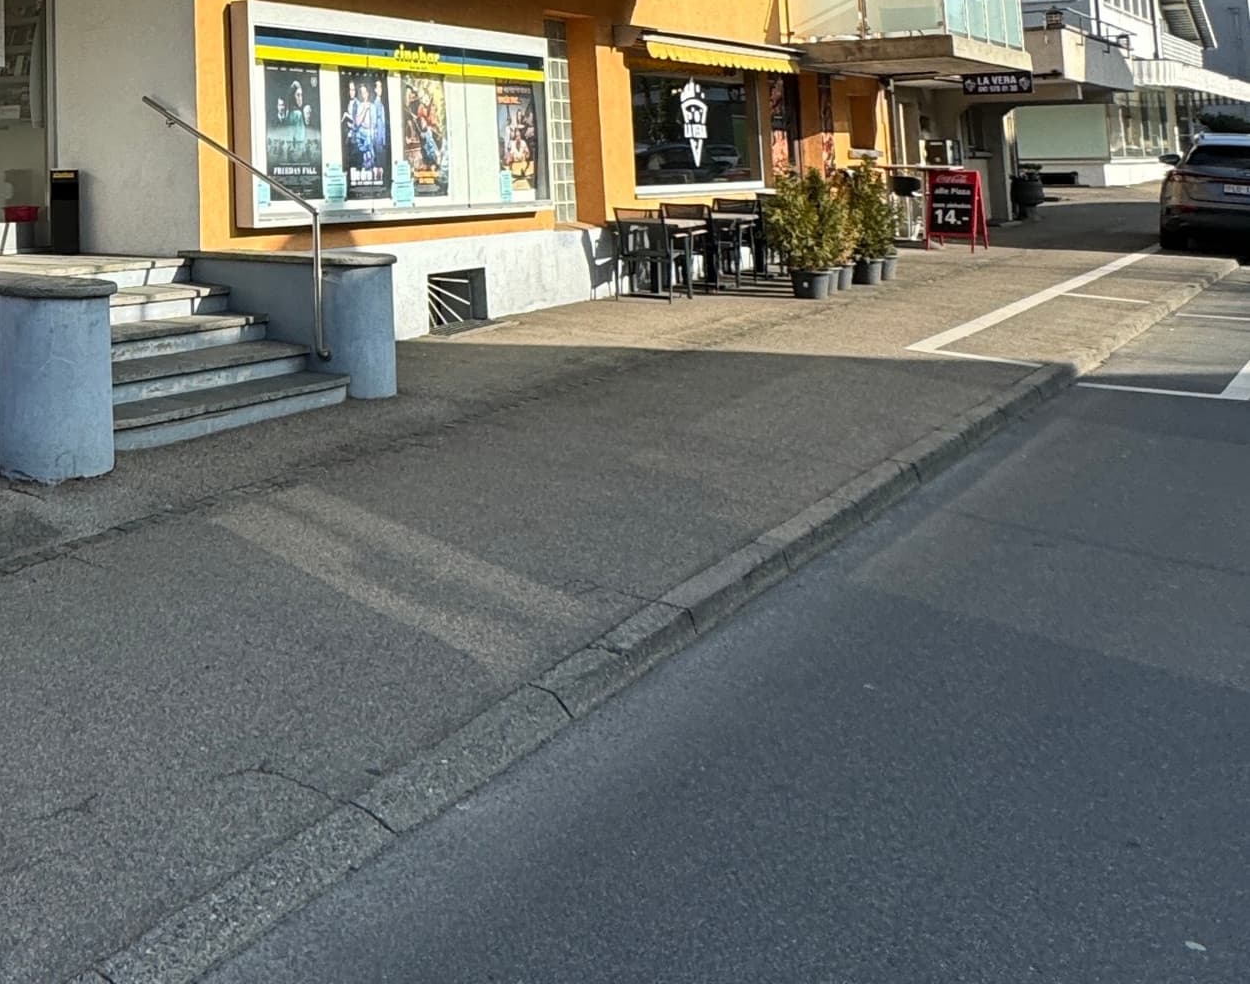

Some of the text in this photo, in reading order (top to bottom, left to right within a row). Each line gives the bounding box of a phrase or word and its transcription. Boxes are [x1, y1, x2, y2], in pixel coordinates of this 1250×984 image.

[394, 43, 440, 65] cinebar
[977, 76, 990, 86] LA
[934, 208, 969, 225] 14.-
